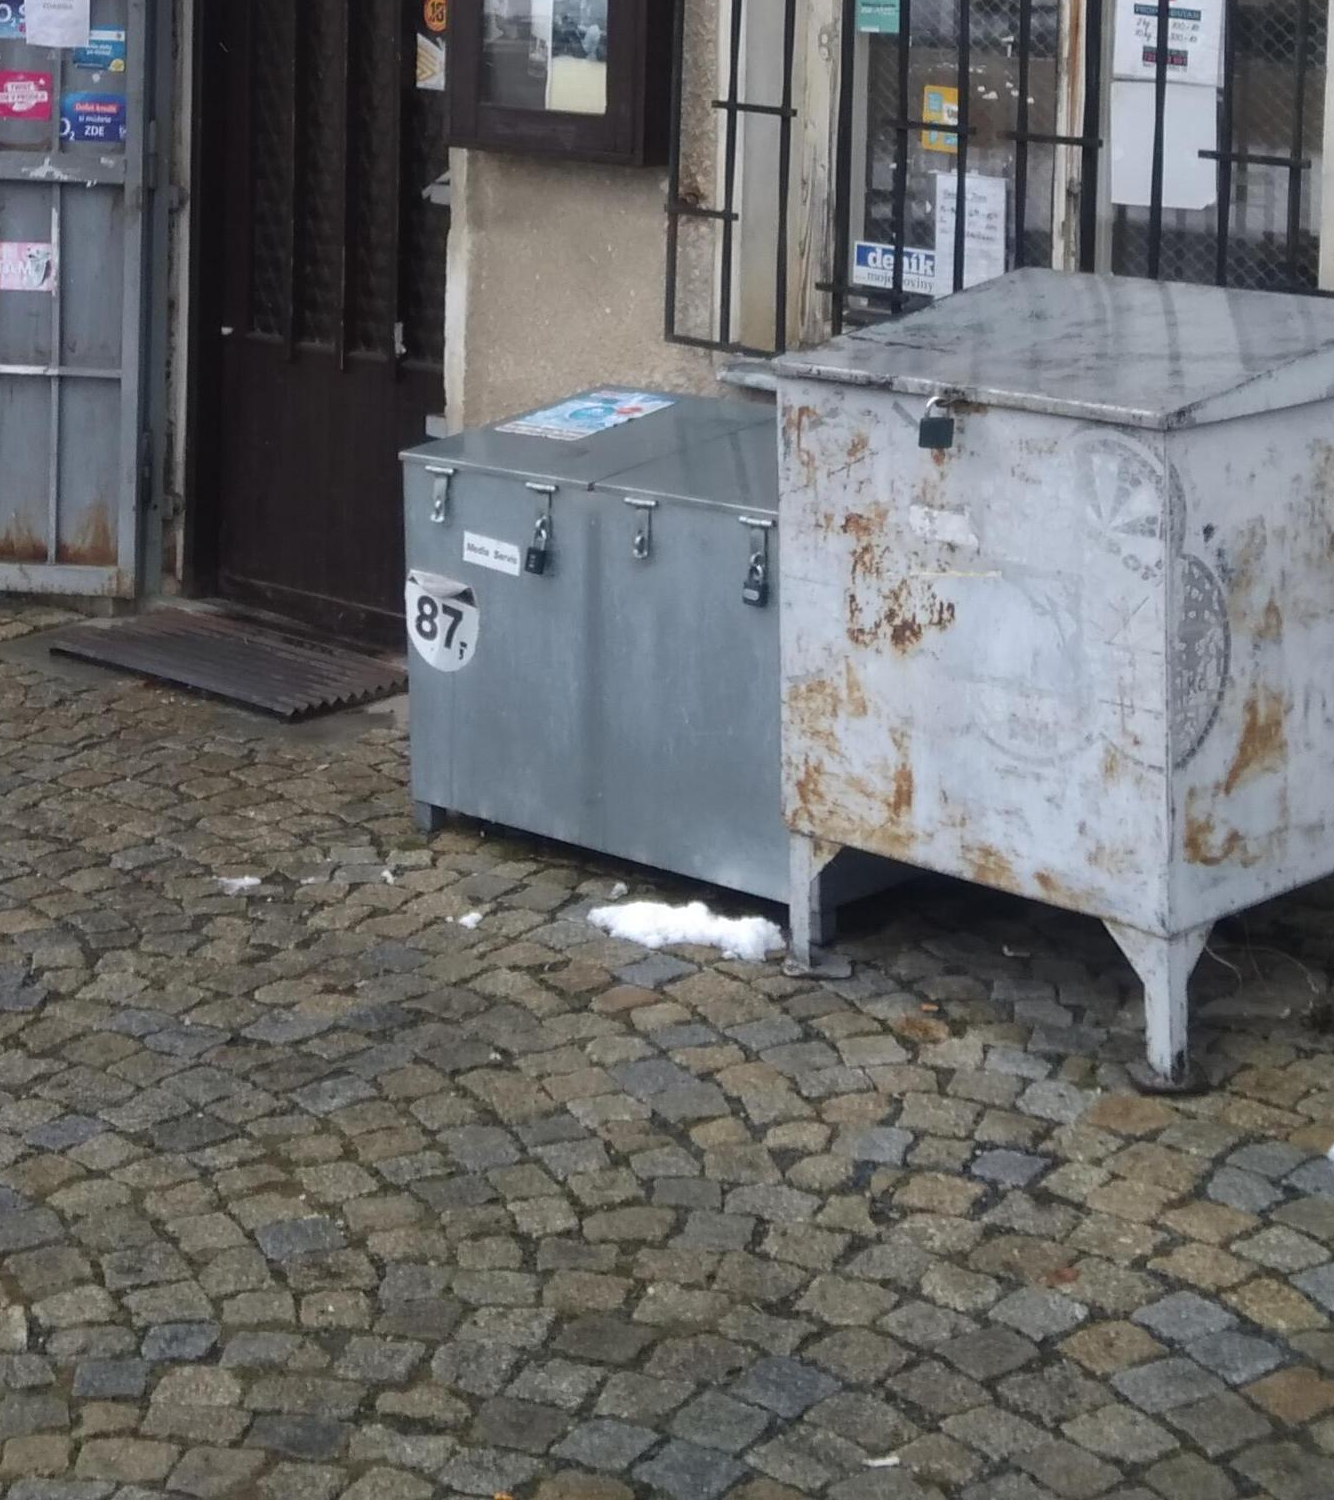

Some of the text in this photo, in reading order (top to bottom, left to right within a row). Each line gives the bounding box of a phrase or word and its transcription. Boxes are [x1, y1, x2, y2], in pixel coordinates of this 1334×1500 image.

[84, 125, 105, 137] ZDE
[901, 275, 933, 292] oviny
[416, 595, 463, 649] 87
